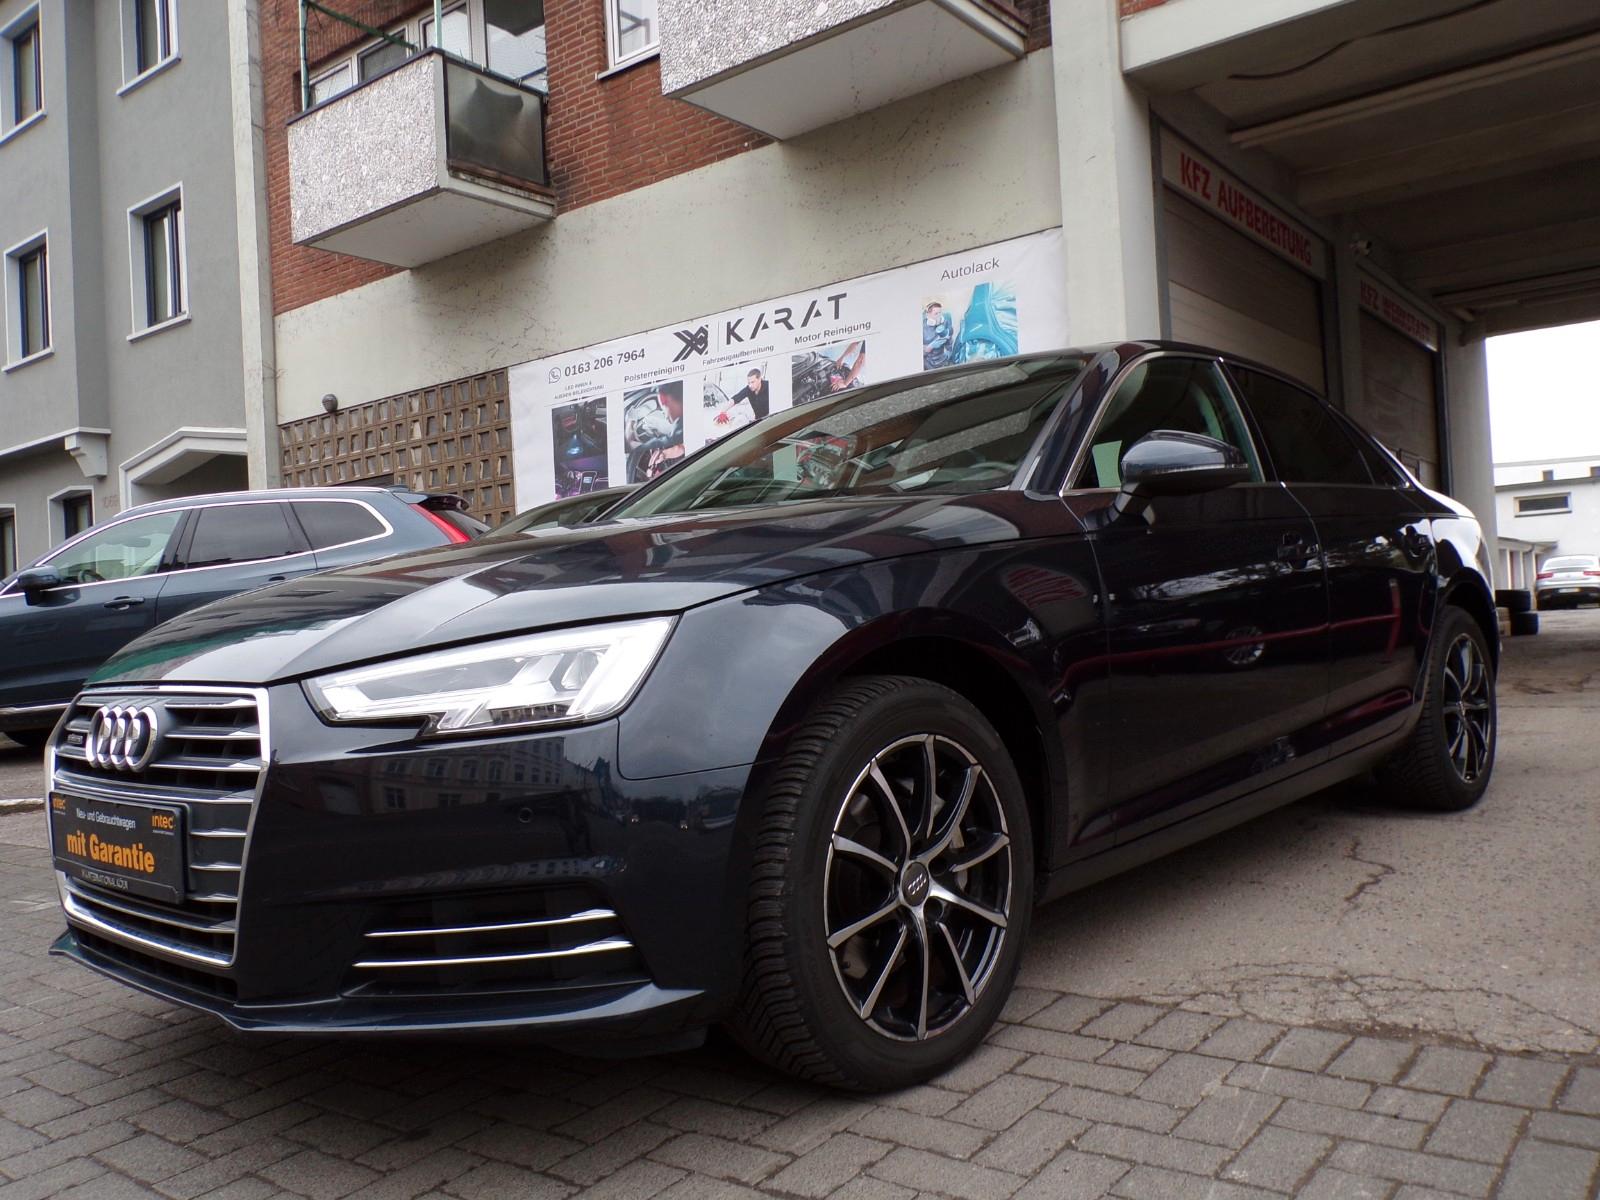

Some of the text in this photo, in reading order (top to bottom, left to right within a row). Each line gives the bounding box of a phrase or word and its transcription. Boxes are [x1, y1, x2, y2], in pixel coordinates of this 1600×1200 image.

[1180, 152, 1312, 266] KFZ AUFBEREITUNG
[940, 256, 1000, 281] Autolack
[726, 293, 847, 345] KARAT
[794, 321, 871, 345] Motor Reinigung
[564, 348, 645, 377] 0163 206 7964
[702, 345, 774, 366] Fahrzeugaufbereitung
[96, 811, 136, 830] Gebrauchtwagen
[152, 814, 174, 829] intec
[66, 830, 155, 873] mit Garantie
